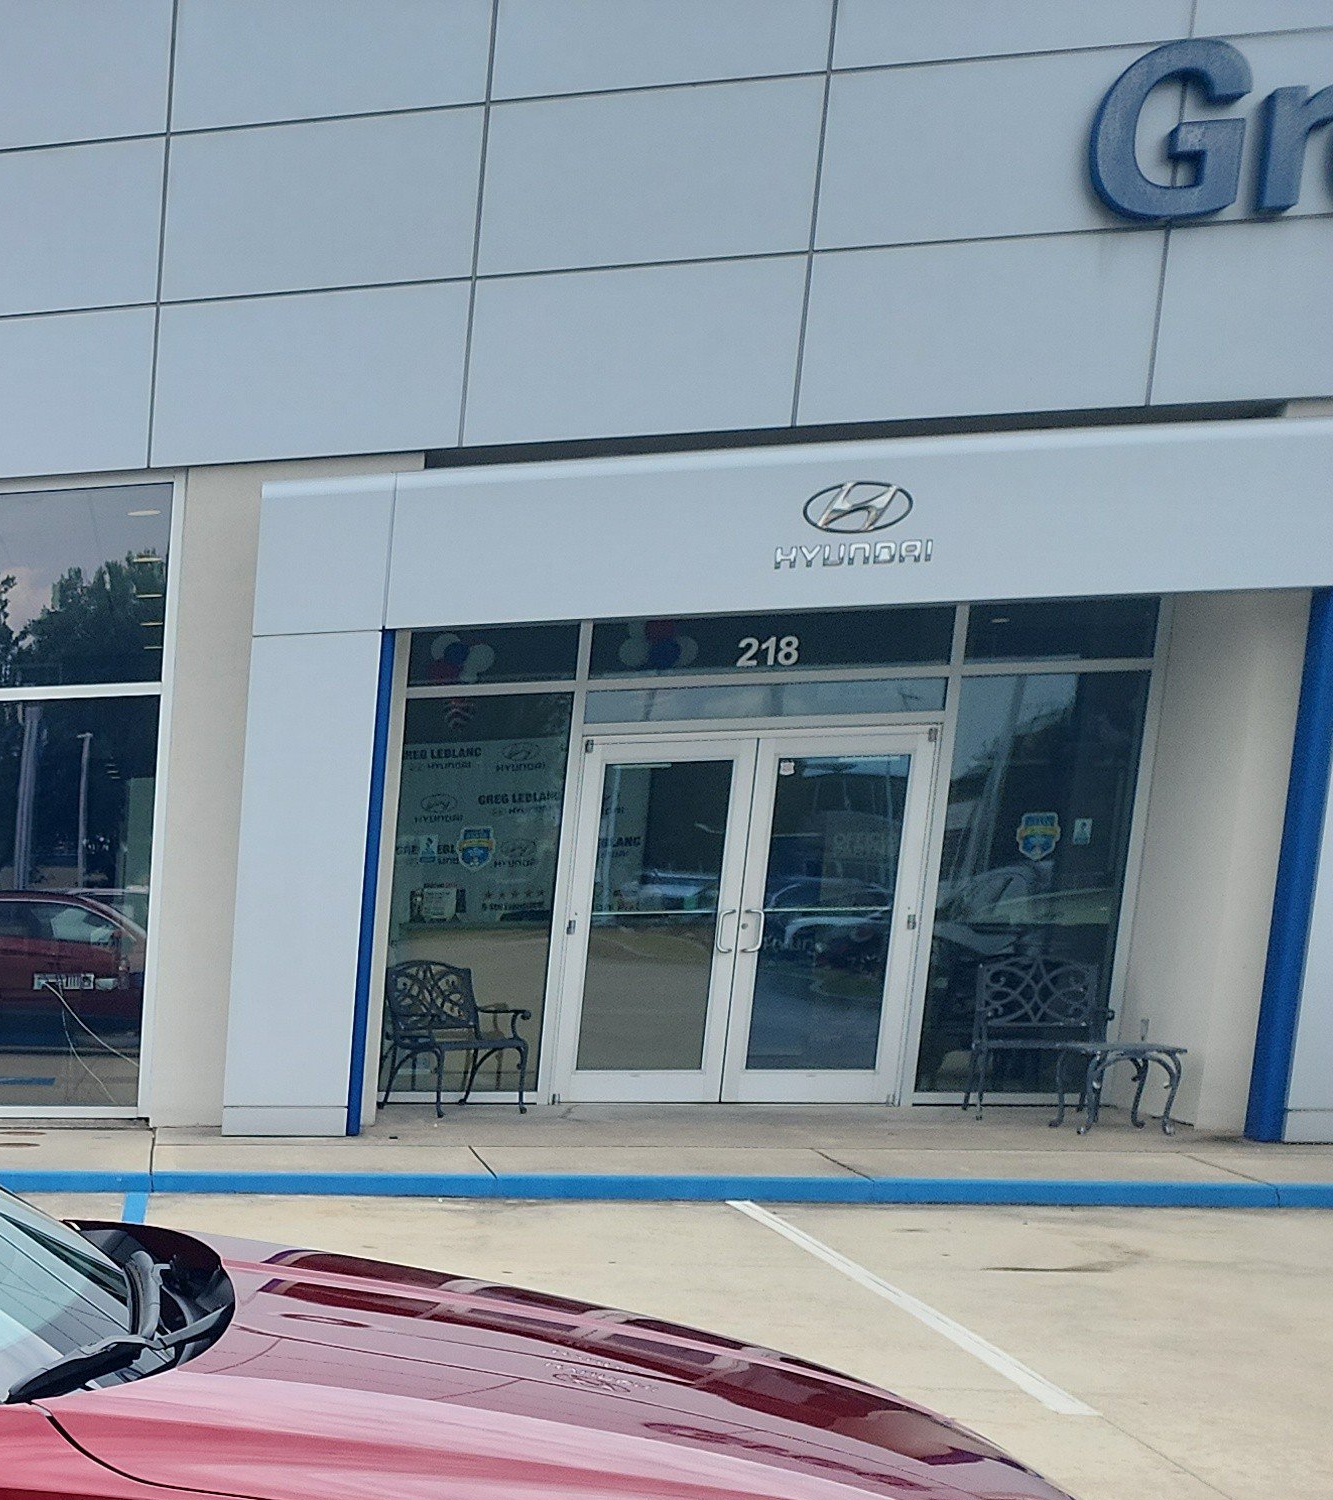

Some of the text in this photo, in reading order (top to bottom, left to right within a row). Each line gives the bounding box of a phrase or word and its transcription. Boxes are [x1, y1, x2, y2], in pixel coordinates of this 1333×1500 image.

[774, 539, 933, 570] HYUNDAI
[736, 635, 800, 668] 218
[430, 746, 482, 760] LEBLANC
[477, 793, 509, 806] GREG
